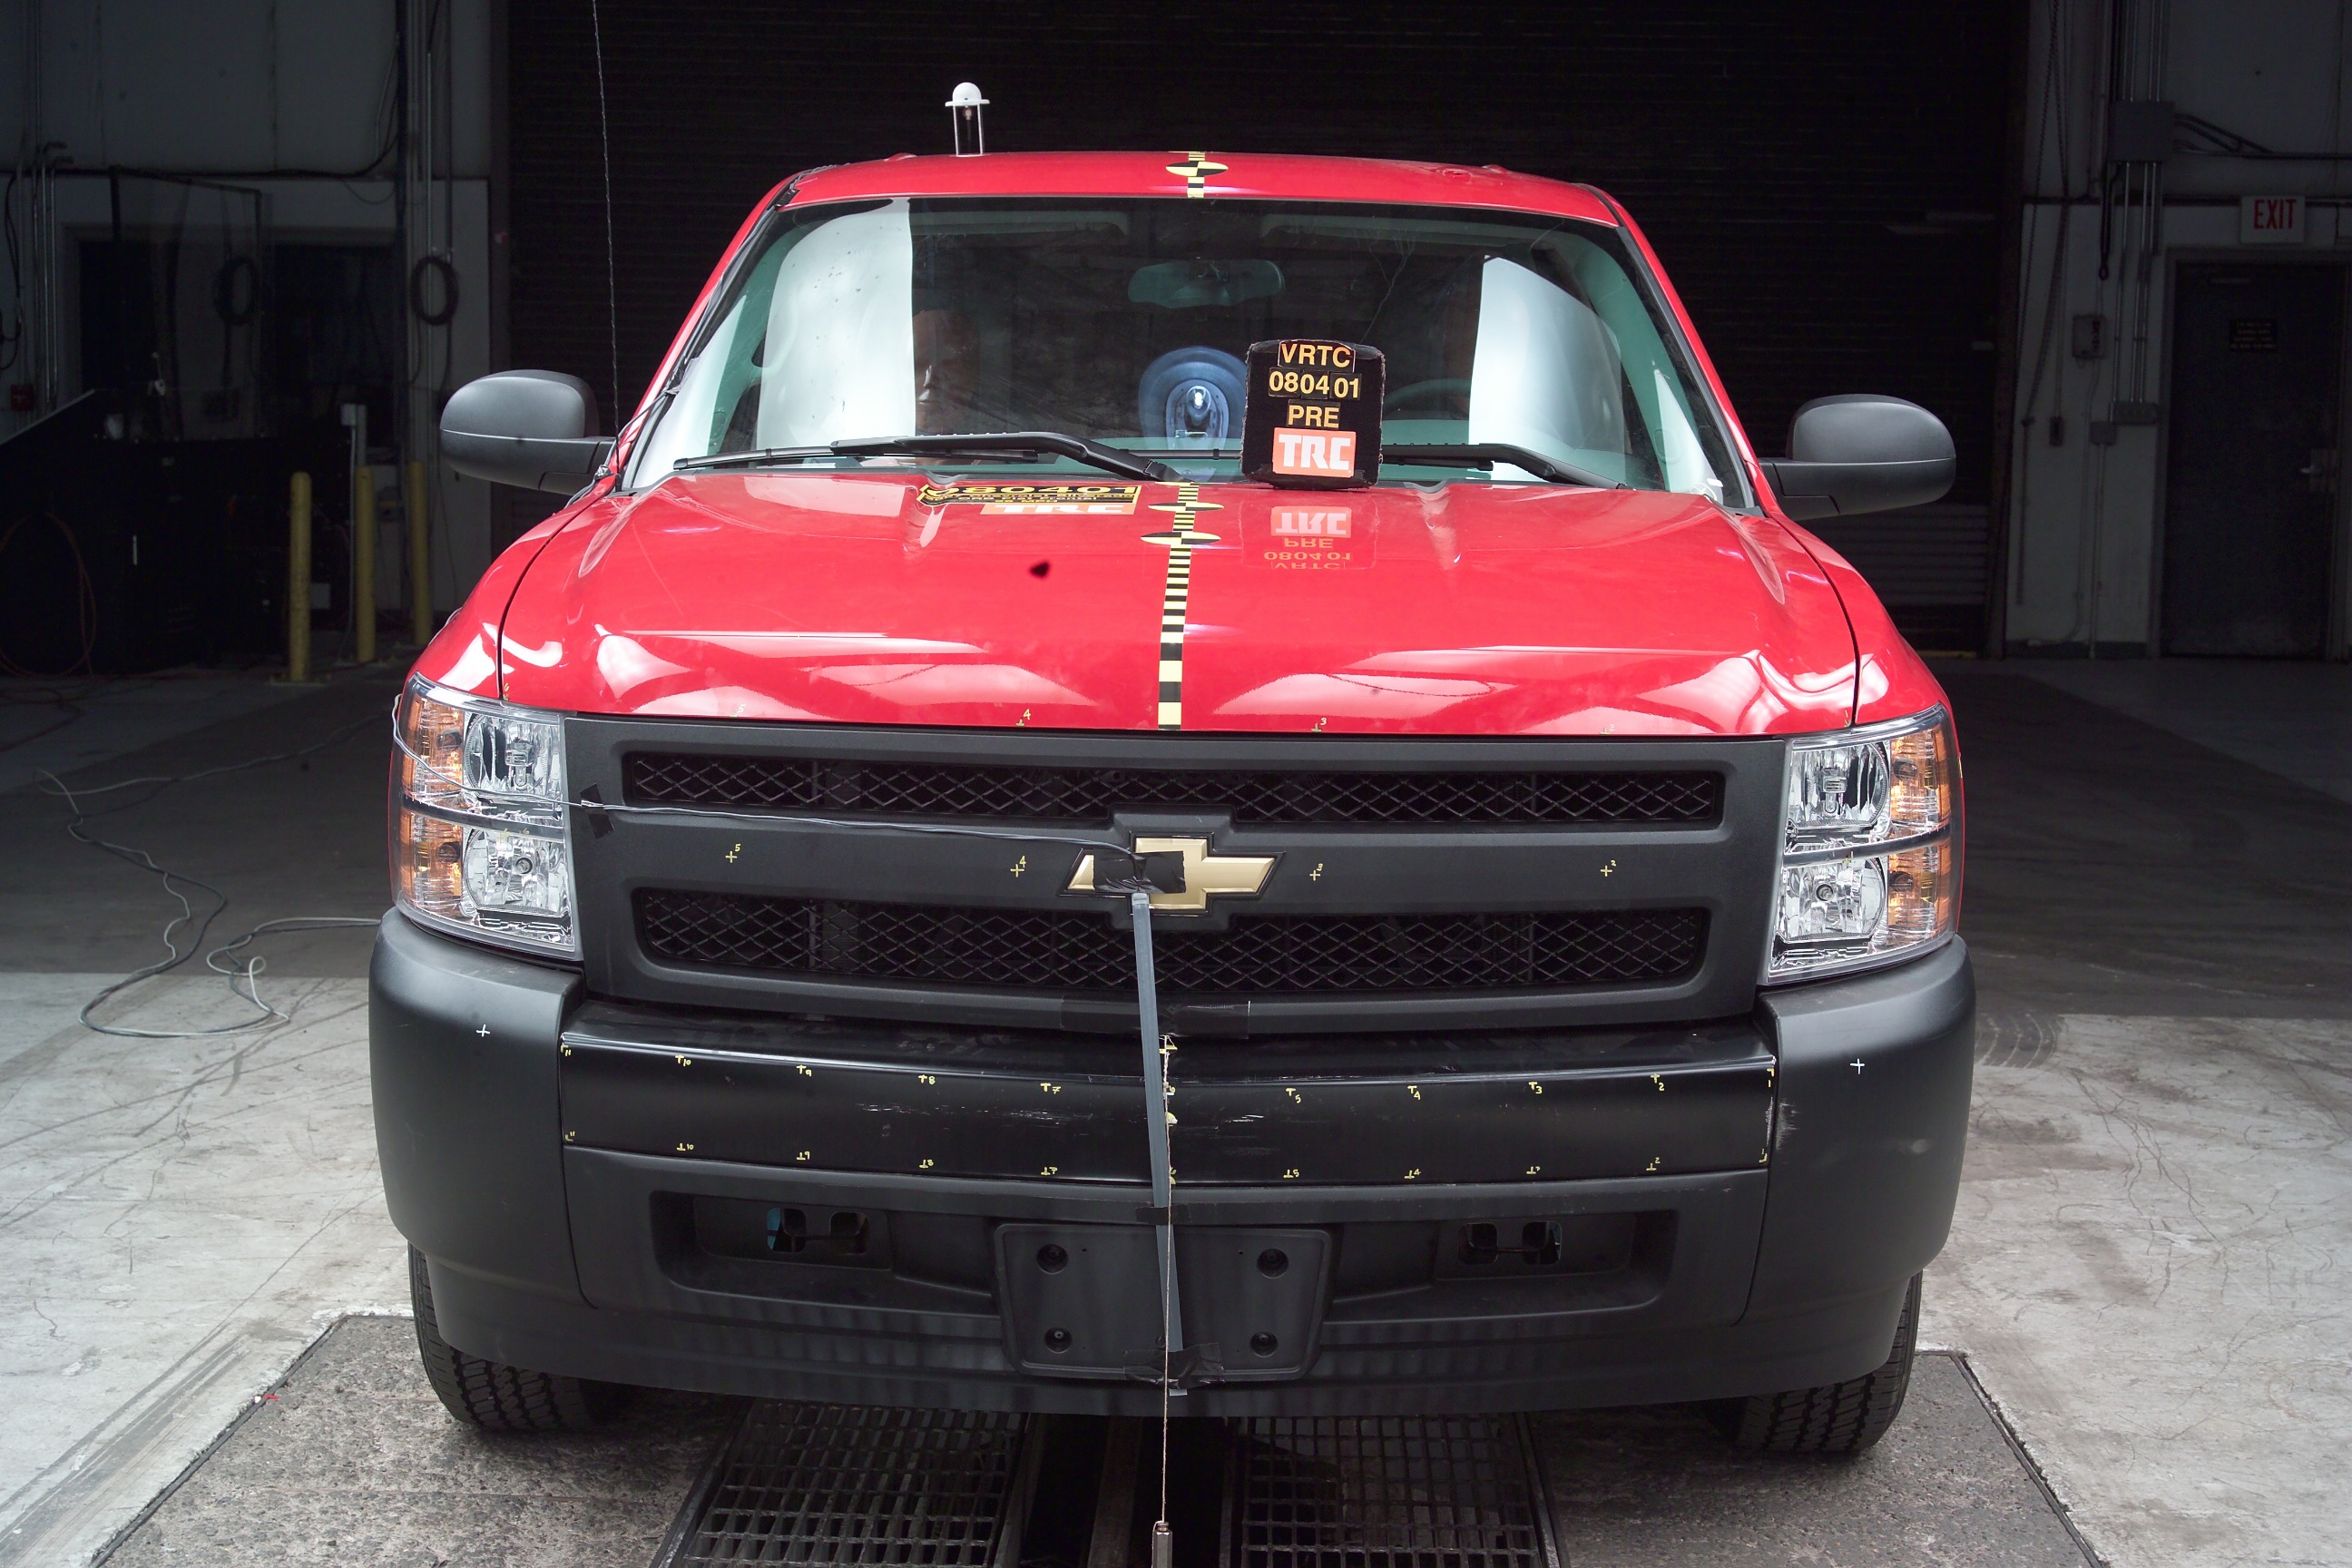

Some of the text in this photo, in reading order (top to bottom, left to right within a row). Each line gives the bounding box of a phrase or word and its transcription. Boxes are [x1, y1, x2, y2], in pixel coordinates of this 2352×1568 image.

[2253, 199, 2297, 230] EXIT
[1280, 343, 1352, 368] VRTC
[1287, 405, 1340, 428] PRE
[1279, 434, 1351, 470] TRC
[995, 505, 1124, 513] TRC
